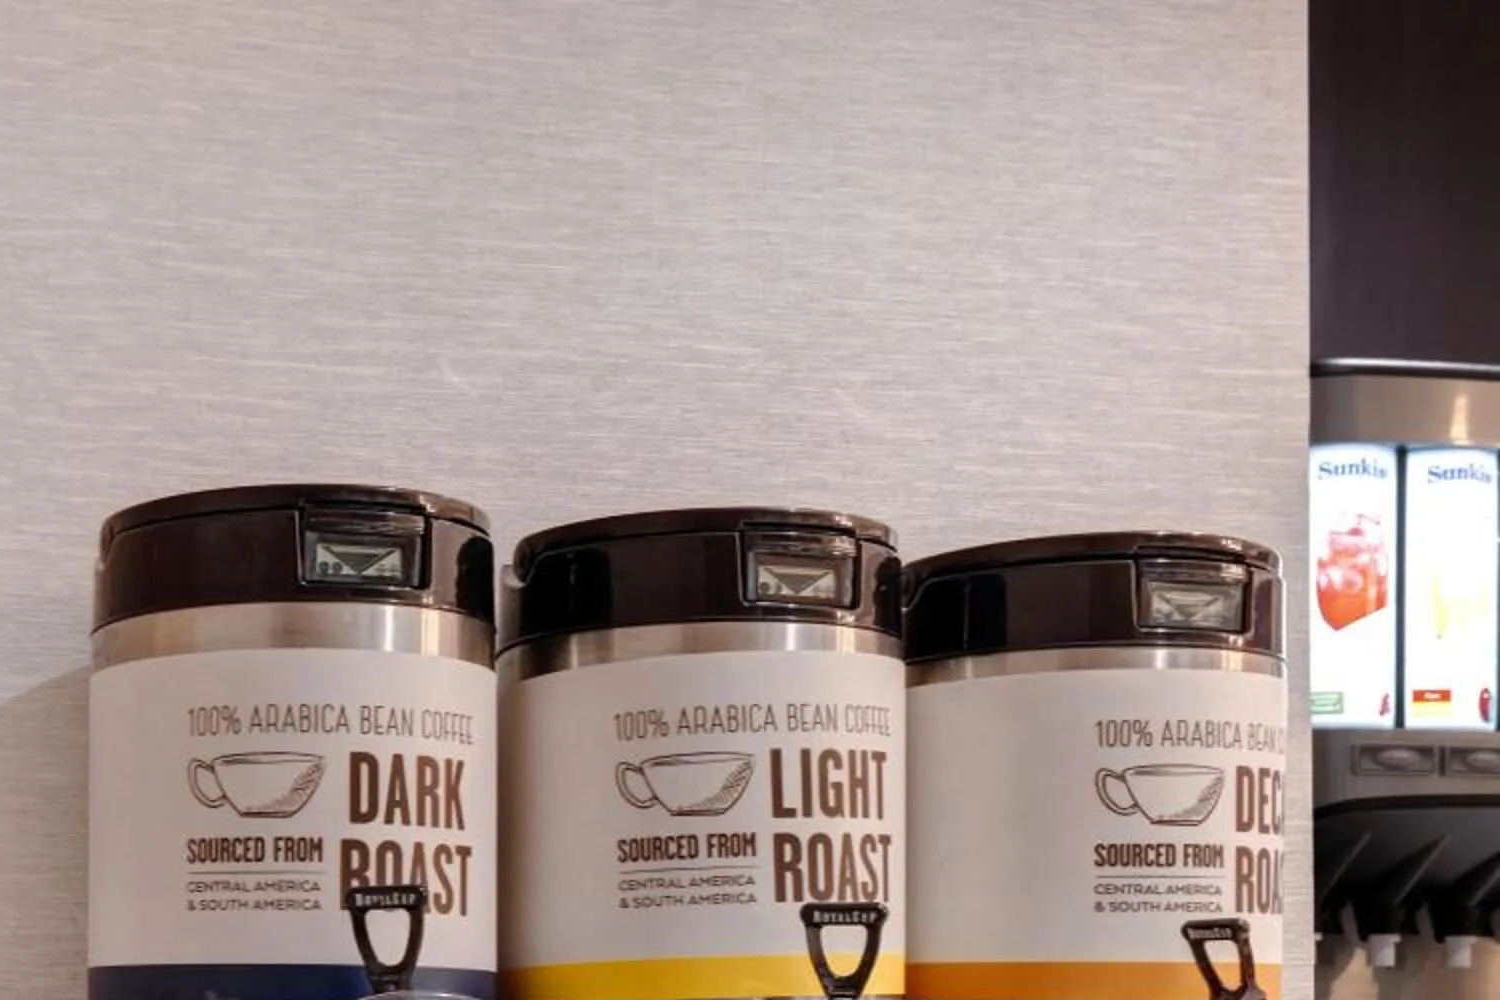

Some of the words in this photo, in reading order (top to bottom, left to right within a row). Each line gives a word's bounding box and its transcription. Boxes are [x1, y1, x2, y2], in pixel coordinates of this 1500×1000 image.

[188, 706, 242, 737] 100%
[249, 703, 350, 735] ARABICA
[360, 706, 414, 737] BEAN
[421, 710, 475, 746] COFFEE
[614, 709, 669, 741] 100%
[677, 703, 778, 734] ARABICA
[787, 703, 839, 733] BEAN
[844, 705, 893, 737] COFFEE
[1095, 721, 1153, 748] 100%
[1160, 720, 1242, 749] ARABICA
[349, 751, 466, 831] DARK
[769, 748, 887, 820] LIGHT
[1235, 766, 1284, 834] DEC
[187, 837, 266, 865] SOURCED
[273, 837, 324, 863] FROM
[617, 834, 700, 863] SOURCED
[706, 832, 758, 858] FROM
[1093, 843, 1177, 868] SOURCED
[1183, 845, 1224, 868] FROM
[773, 833, 892, 903] ROAST
[187, 880, 255, 894] CENTRAL
[255, 880, 322, 894] AMERICA
[618, 876, 687, 892] CENTRAL
[688, 875, 756, 889] AMERICA
[1094, 884, 1161, 896] CENTRAL
[1164, 884, 1222, 896] AMERICA
[199, 899, 249, 912] SOUTH
[252, 899, 323, 912] AMERICA
[632, 894, 684, 909] SOUTH
[687, 893, 758, 907] AMERICA
[1109, 901, 1161, 913] SOUTH
[1165, 901, 1224, 913] AMERICA
